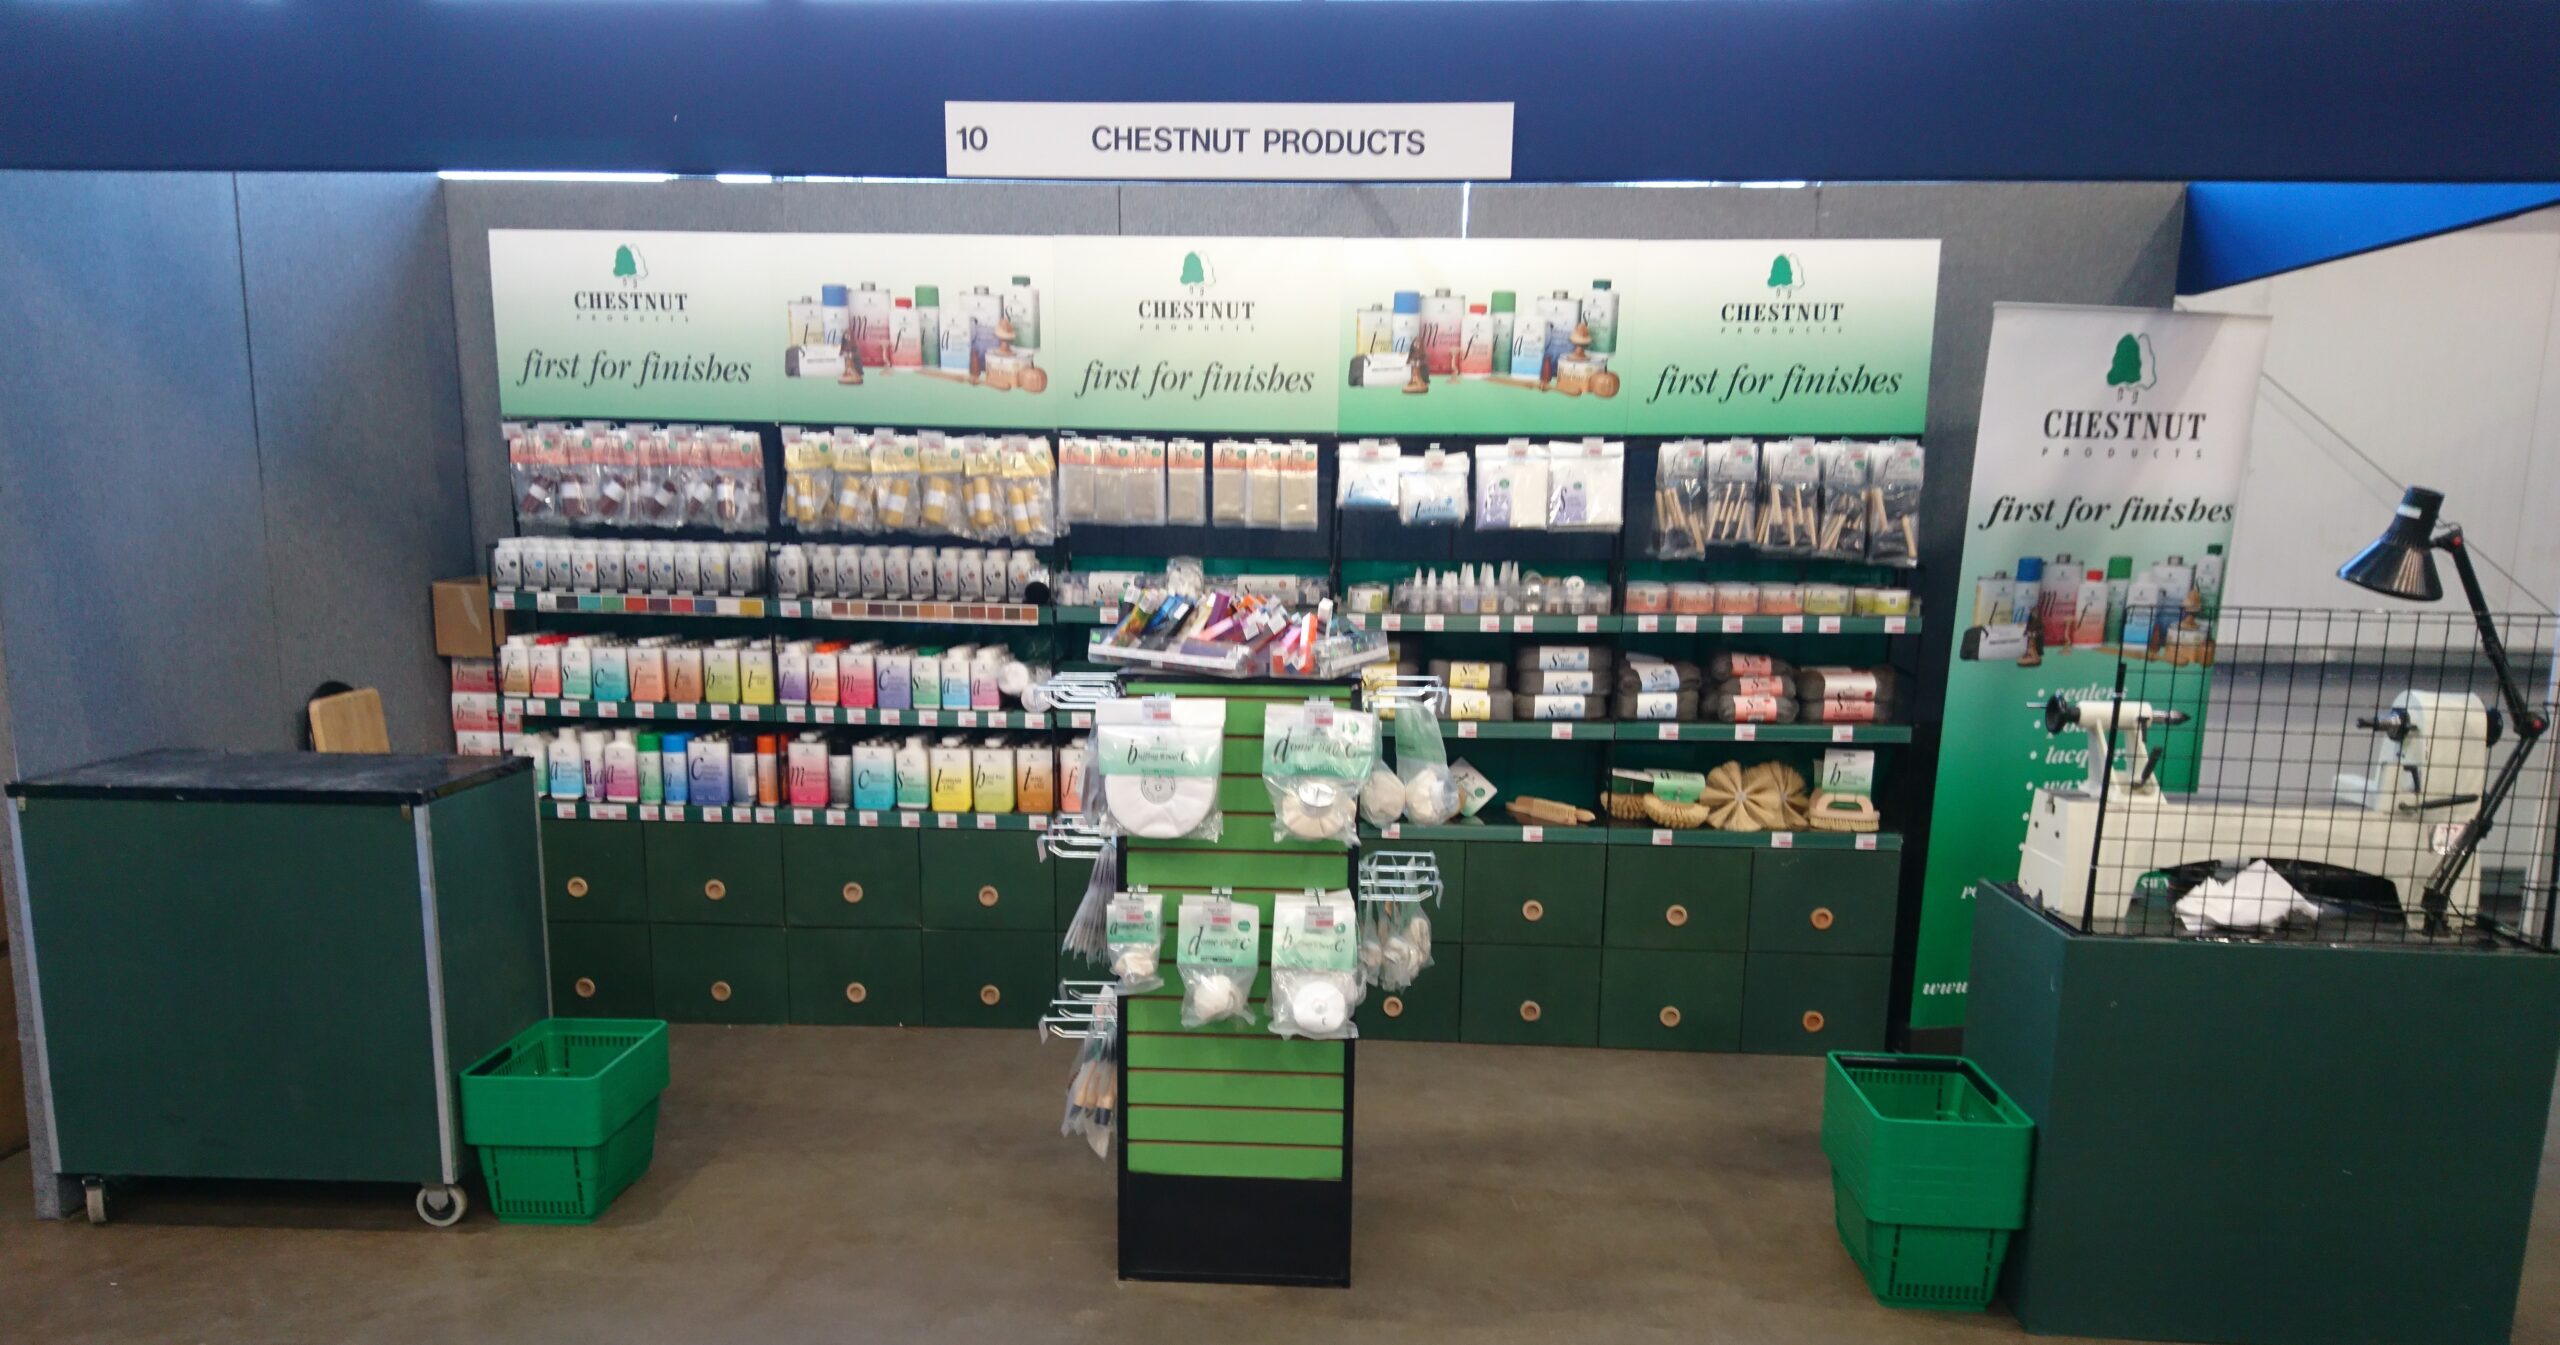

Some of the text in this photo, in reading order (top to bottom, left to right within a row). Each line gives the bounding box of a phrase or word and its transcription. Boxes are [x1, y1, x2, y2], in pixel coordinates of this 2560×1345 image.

[956, 126, 988, 151] 10
[1091, 126, 1426, 155] CHESTNUT PRODUCTS
[574, 291, 688, 311] CHESTNUT
[1138, 300, 1255, 319] CHESTNUT
[1721, 302, 1844, 322] CHESTNUT
[516, 349, 752, 390] first for finishes
[1074, 359, 1315, 401] first for finishes
[1646, 362, 1903, 404] first for finishes
[2044, 409, 2206, 441] CHESTNUT
[1978, 495, 2235, 531] first for finishes
